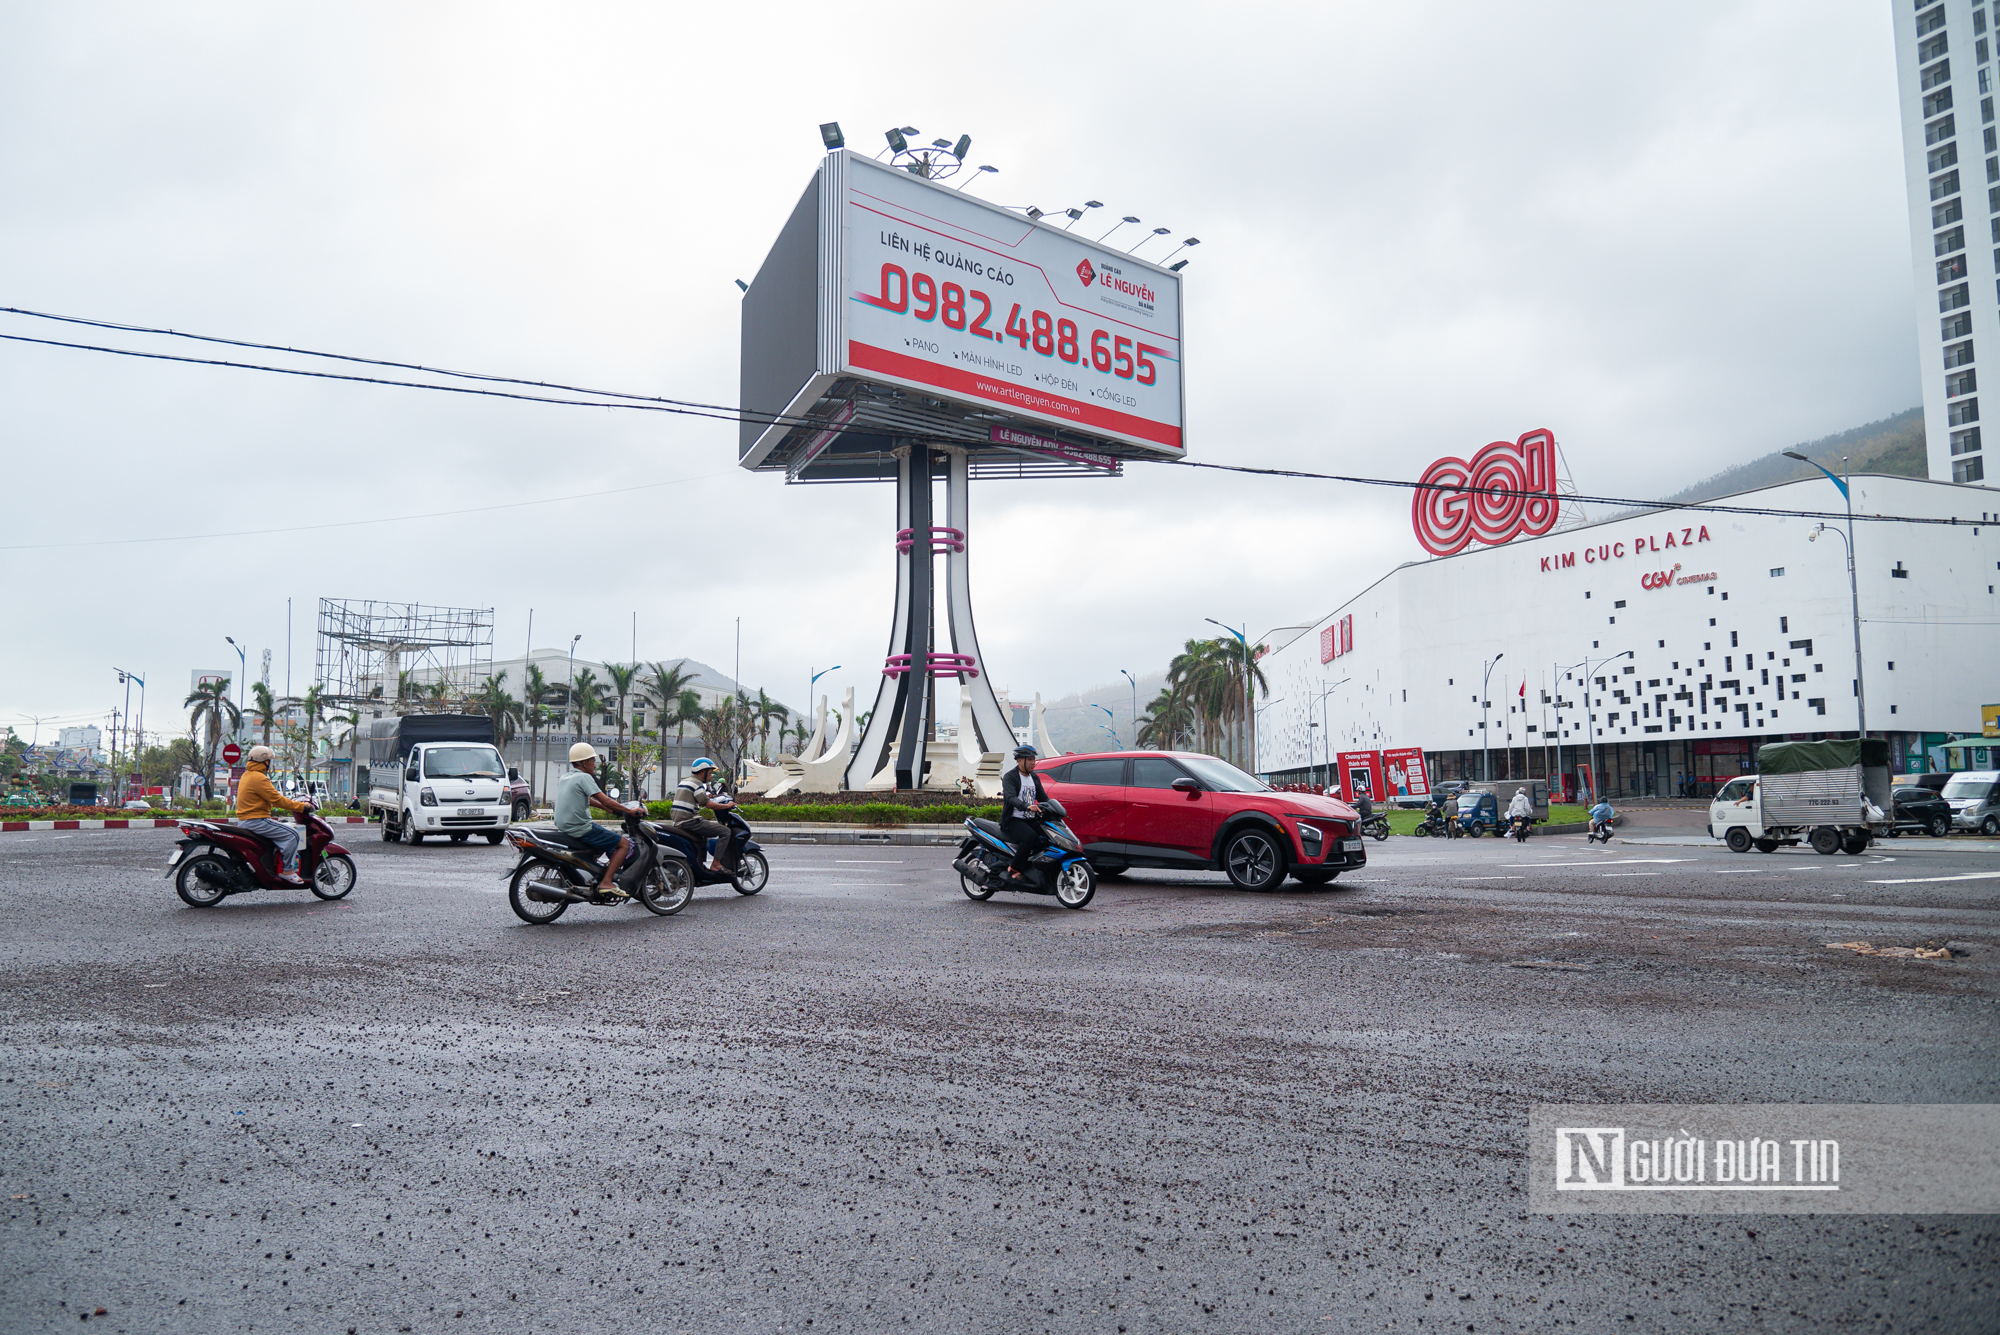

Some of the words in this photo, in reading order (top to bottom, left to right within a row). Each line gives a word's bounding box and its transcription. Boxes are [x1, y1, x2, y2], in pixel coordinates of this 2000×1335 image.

[881, 231, 909, 252] LIÊN
[914, 242, 931, 262] HỆ
[935, 251, 983, 275] QUẢNG
[987, 267, 1014, 286] CÁO
[1100, 272, 1112, 288] LÊ
[1114, 283, 1155, 303] NGUYỄN
[881, 262, 1157, 387] 0982.488.655
[912, 337, 939, 354] PANO
[961, 351, 982, 366] MÀN
[983, 356, 1005, 372] HÌNH
[1006, 363, 1023, 377] LED
[1041, 373, 1060, 387] HỘP
[1061, 378, 1078, 392] ĐÈN
[976, 381, 1081, 415] www.artlenguyen.com.vn
[1122, 397, 1137, 408] LED
[1000, 429, 1010, 441] LÊ
[1412, 428, 1559, 556] GO!
[1540, 551, 1575, 572] KIM
[1584, 542, 1625, 564] CUC
[1635, 525, 1711, 555] PLAZA
[1641, 569, 1675, 590] CGV
[1676, 571, 1718, 586] CINEMAS
